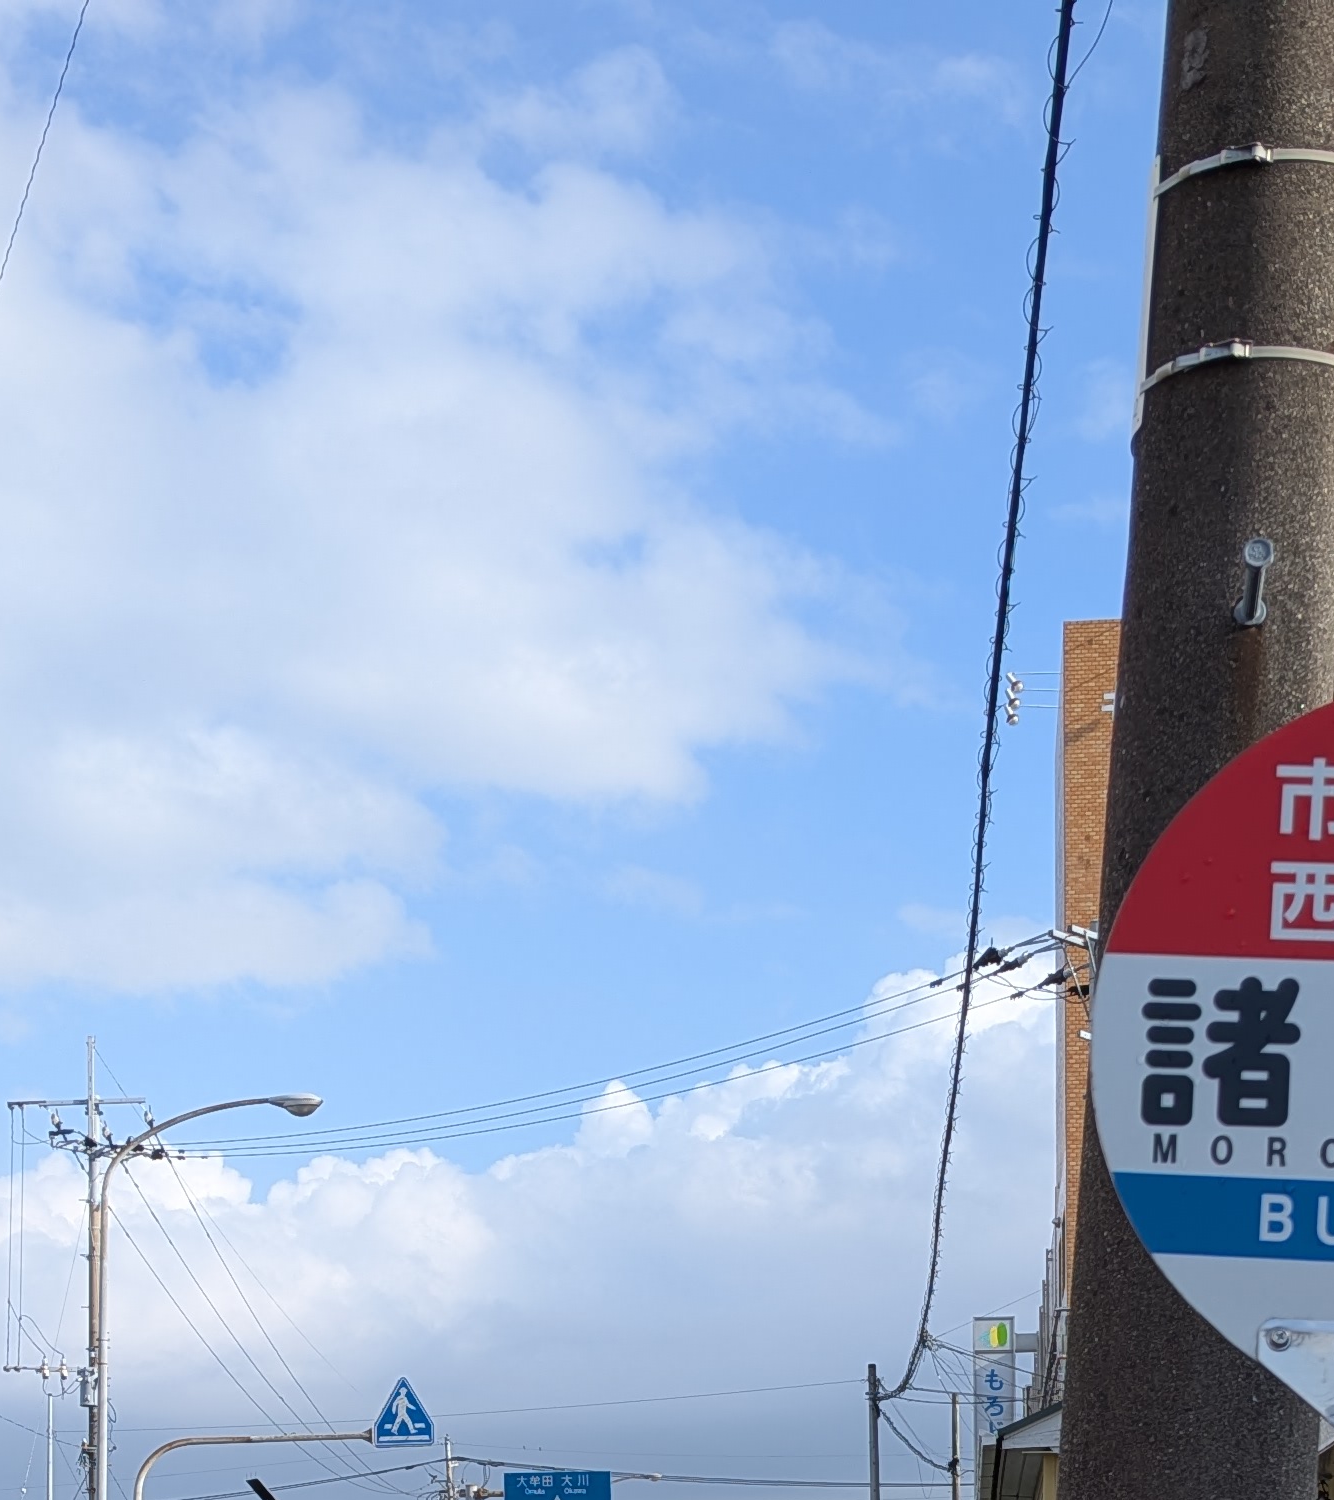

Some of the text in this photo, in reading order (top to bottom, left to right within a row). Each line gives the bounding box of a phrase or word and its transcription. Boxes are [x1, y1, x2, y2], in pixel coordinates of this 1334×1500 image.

[516, 1474, 589, 1488] 大牟田 大川
